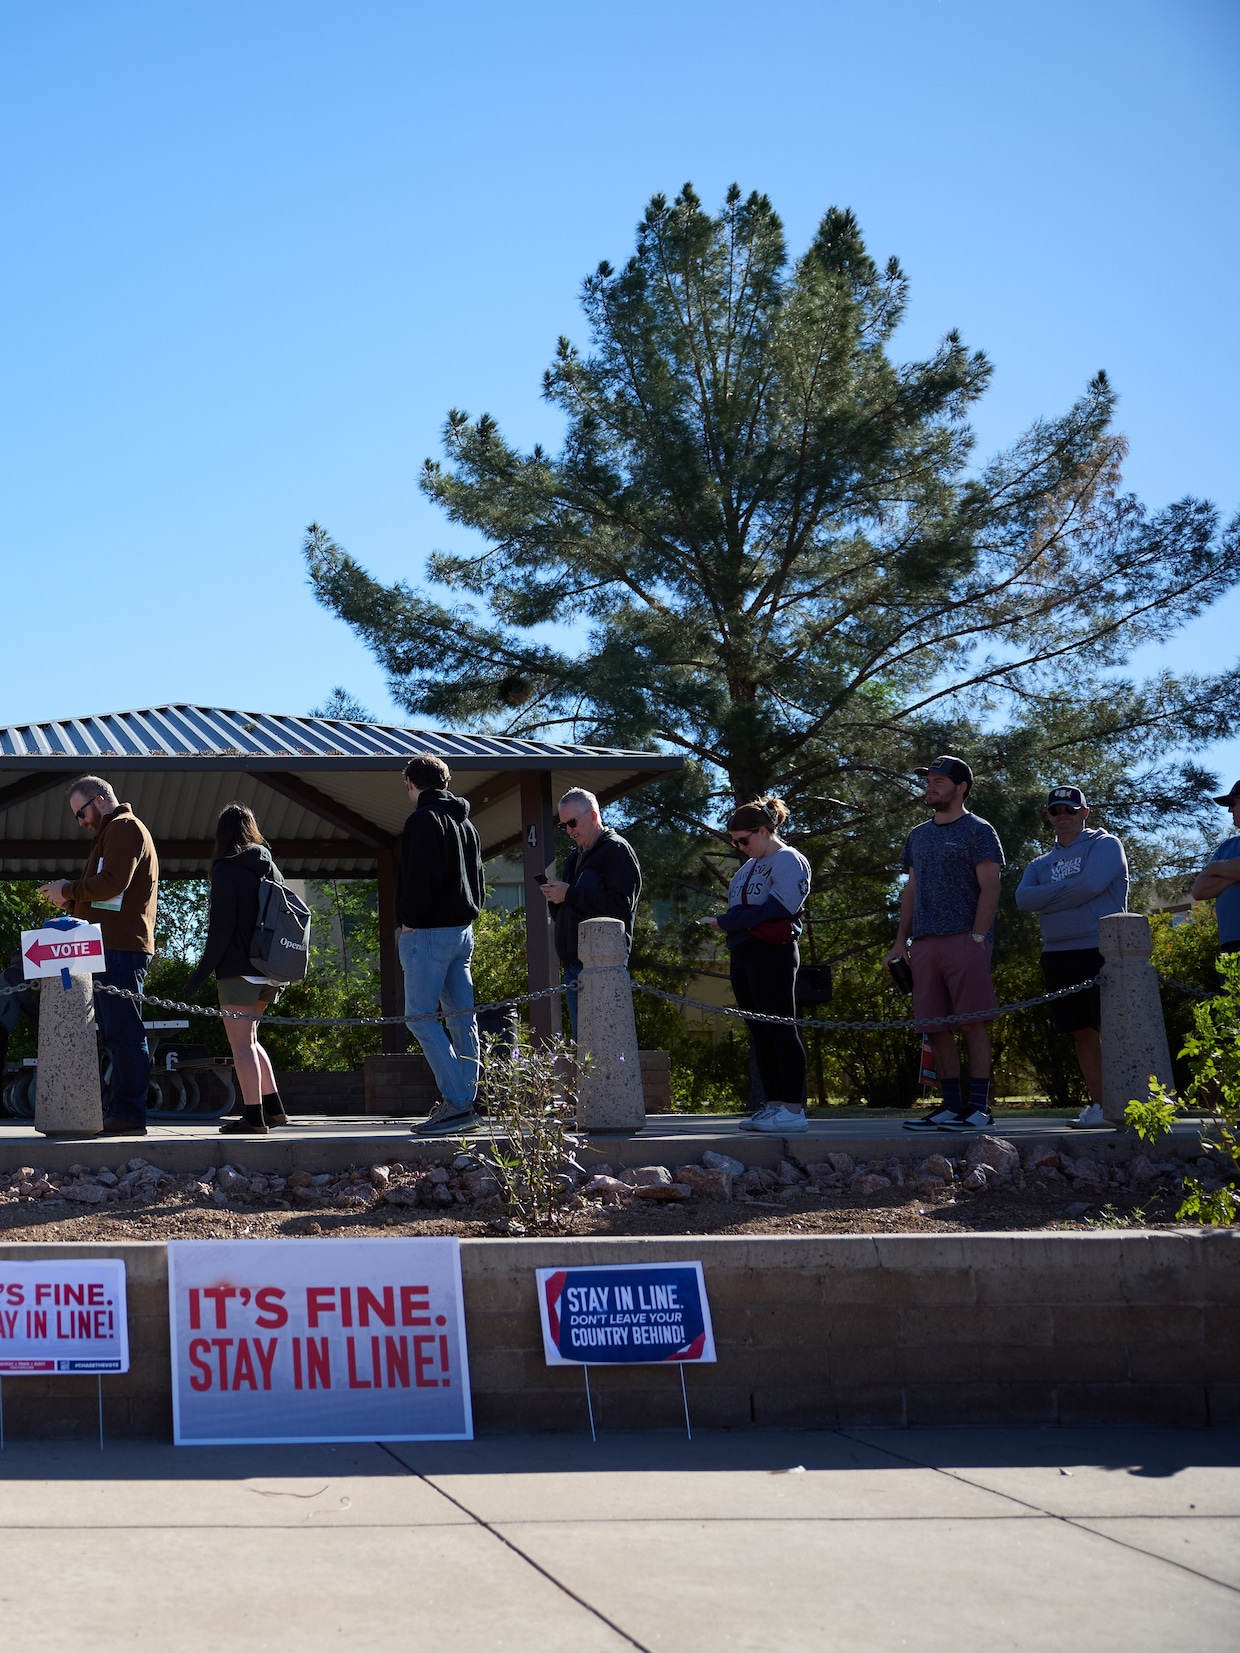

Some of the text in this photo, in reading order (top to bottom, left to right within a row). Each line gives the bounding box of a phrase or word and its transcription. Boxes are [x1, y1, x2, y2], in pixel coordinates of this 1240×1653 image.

[527, 825, 537, 847] 4
[50, 942, 90, 957] VOTE
[35, 1283, 113, 1306] FINE.
[567, 1285, 684, 1312] STAY IN LINE.
[188, 1285, 447, 1330] IT'S FINE.
[570, 1312, 682, 1326] DON'T LEAVE YOUR
[26, 1310, 47, 1339] IN
[57, 1310, 114, 1339] LINE!
[571, 1325, 686, 1347] COUNTRY BEHIND!
[189, 1334, 451, 1392] STAY IN LINE!
